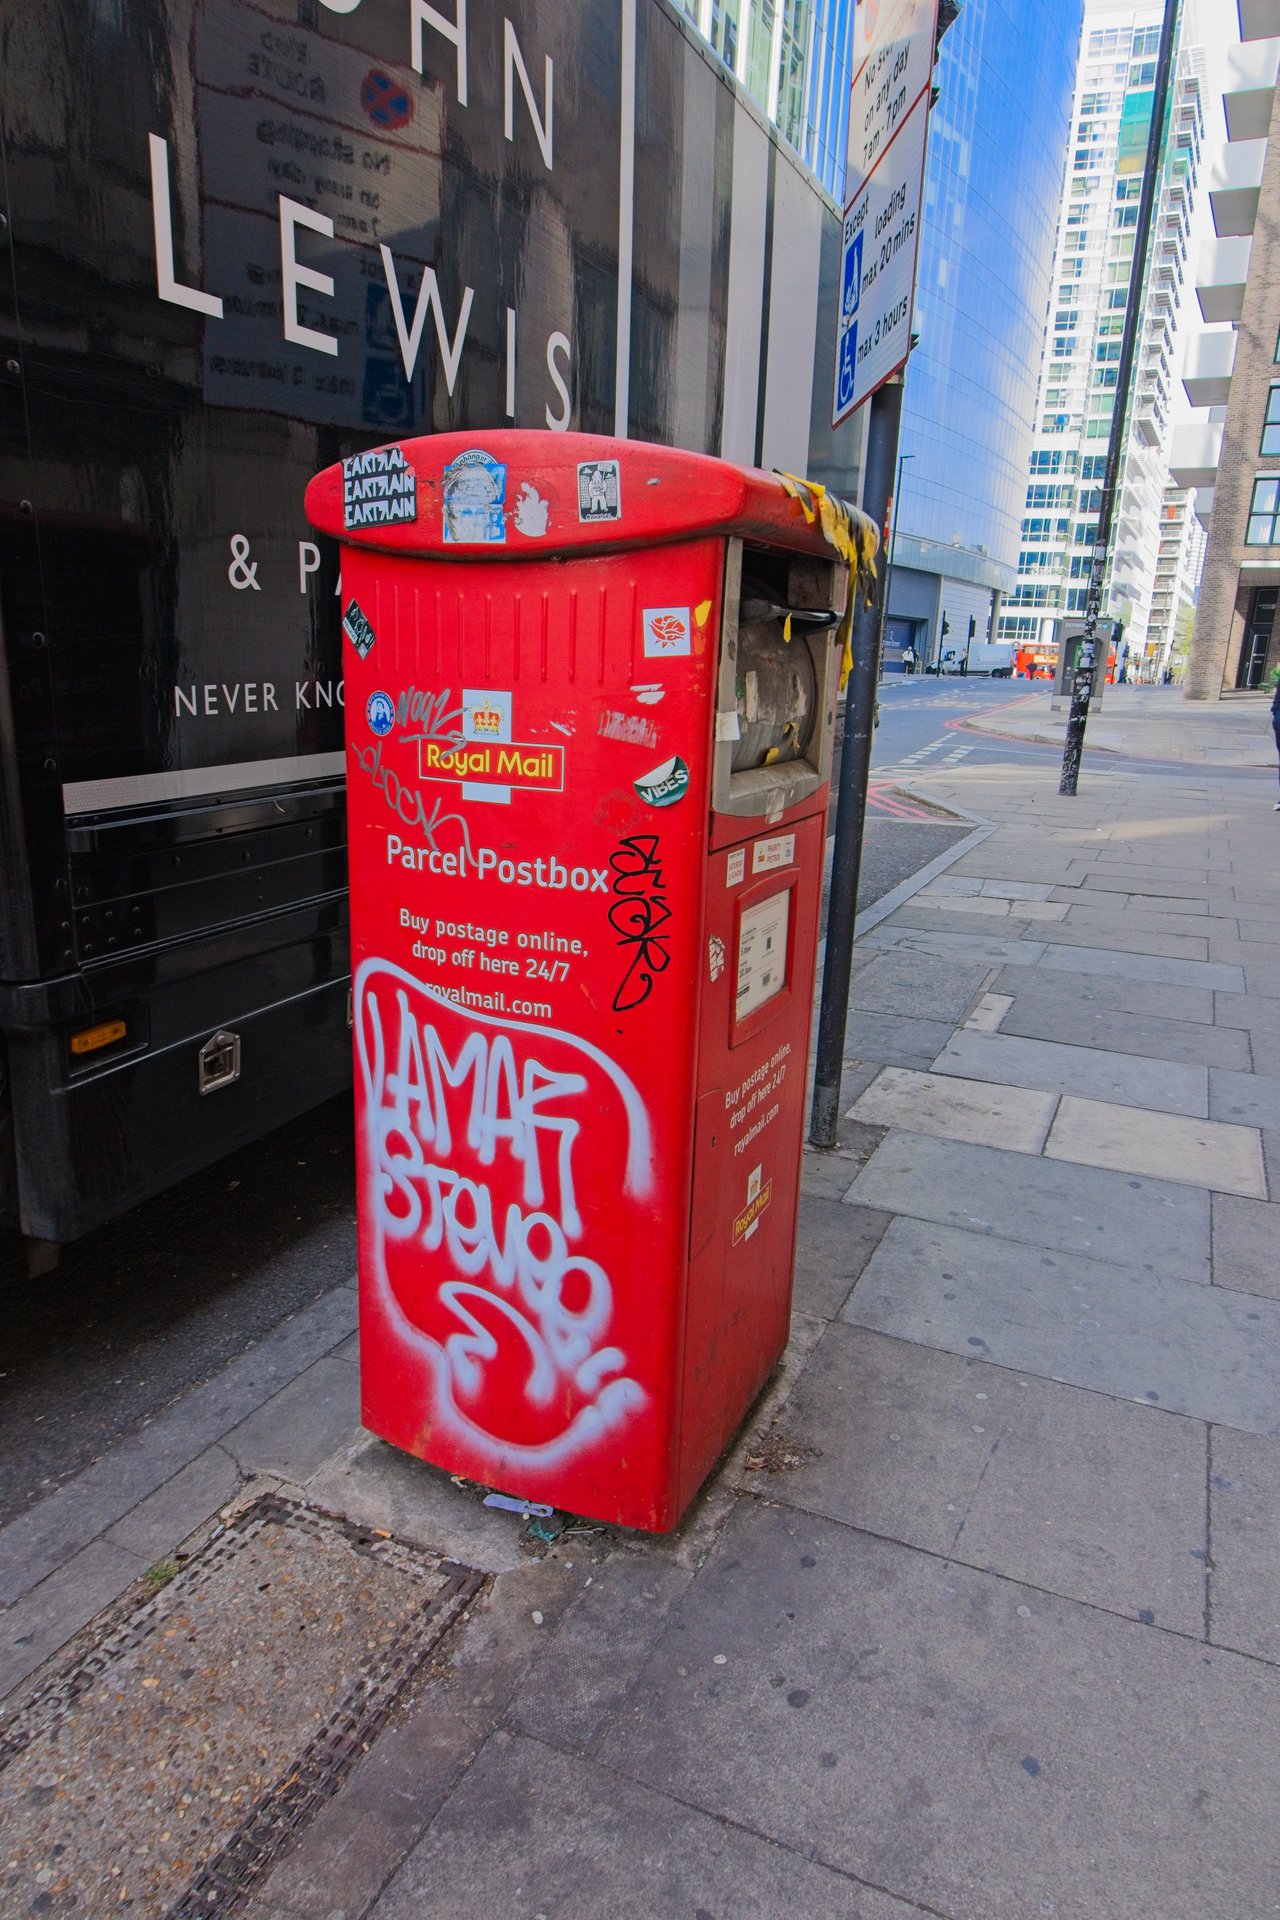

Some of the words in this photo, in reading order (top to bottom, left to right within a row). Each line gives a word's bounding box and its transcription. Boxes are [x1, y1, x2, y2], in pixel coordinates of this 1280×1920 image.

[318, 0, 554, 171] HN
[864, 64, 876, 95] No
[864, 105, 874, 132] on
[876, 73, 891, 113] any
[893, 40, 910, 83] day
[863, 130, 880, 169] 7am
[886, 85, 906, 131] 7pm
[845, 192, 869, 246] Except
[875, 182, 906, 240] loading
[149, 133, 572, 431] LEWIS
[862, 260, 878, 294] max
[880, 236, 892, 272] 20
[893, 212, 915, 256] mins
[857, 334, 873, 365] max
[875, 319, 880, 346] 3
[882, 295, 908, 338] hours
[228, 534, 261, 590] &
[299, 541, 341, 596] P
[175, 682, 279, 717] NEVER
[427, 744, 490, 776] Royal
[497, 751, 553, 778] Mail
[641, 769, 688, 802] VIBES
[387, 834, 467, 877] Parcel
[478, 847, 609, 893] Postbox
[400, 908, 430, 934] Buy
[436, 918, 509, 948] postage
[517, 932, 588, 957] online,
[412, 940, 446, 965] drop
[452, 949, 475, 968] off
[480, 953, 519, 975] here
[526, 959, 570, 982] 24/7
[726, 1088, 740, 1109] Buy
[742, 1062, 769, 1099] postage
[730, 1107, 746, 1129] drop
[747, 1091, 757, 1113] off
[757, 1082, 771, 1104] here
[772, 1064, 786, 1089] 24/7
[734, 1104, 779, 1157] royalmail.com
[735, 1203, 754, 1236] Royal
[755, 1185, 770, 1214] Mail
